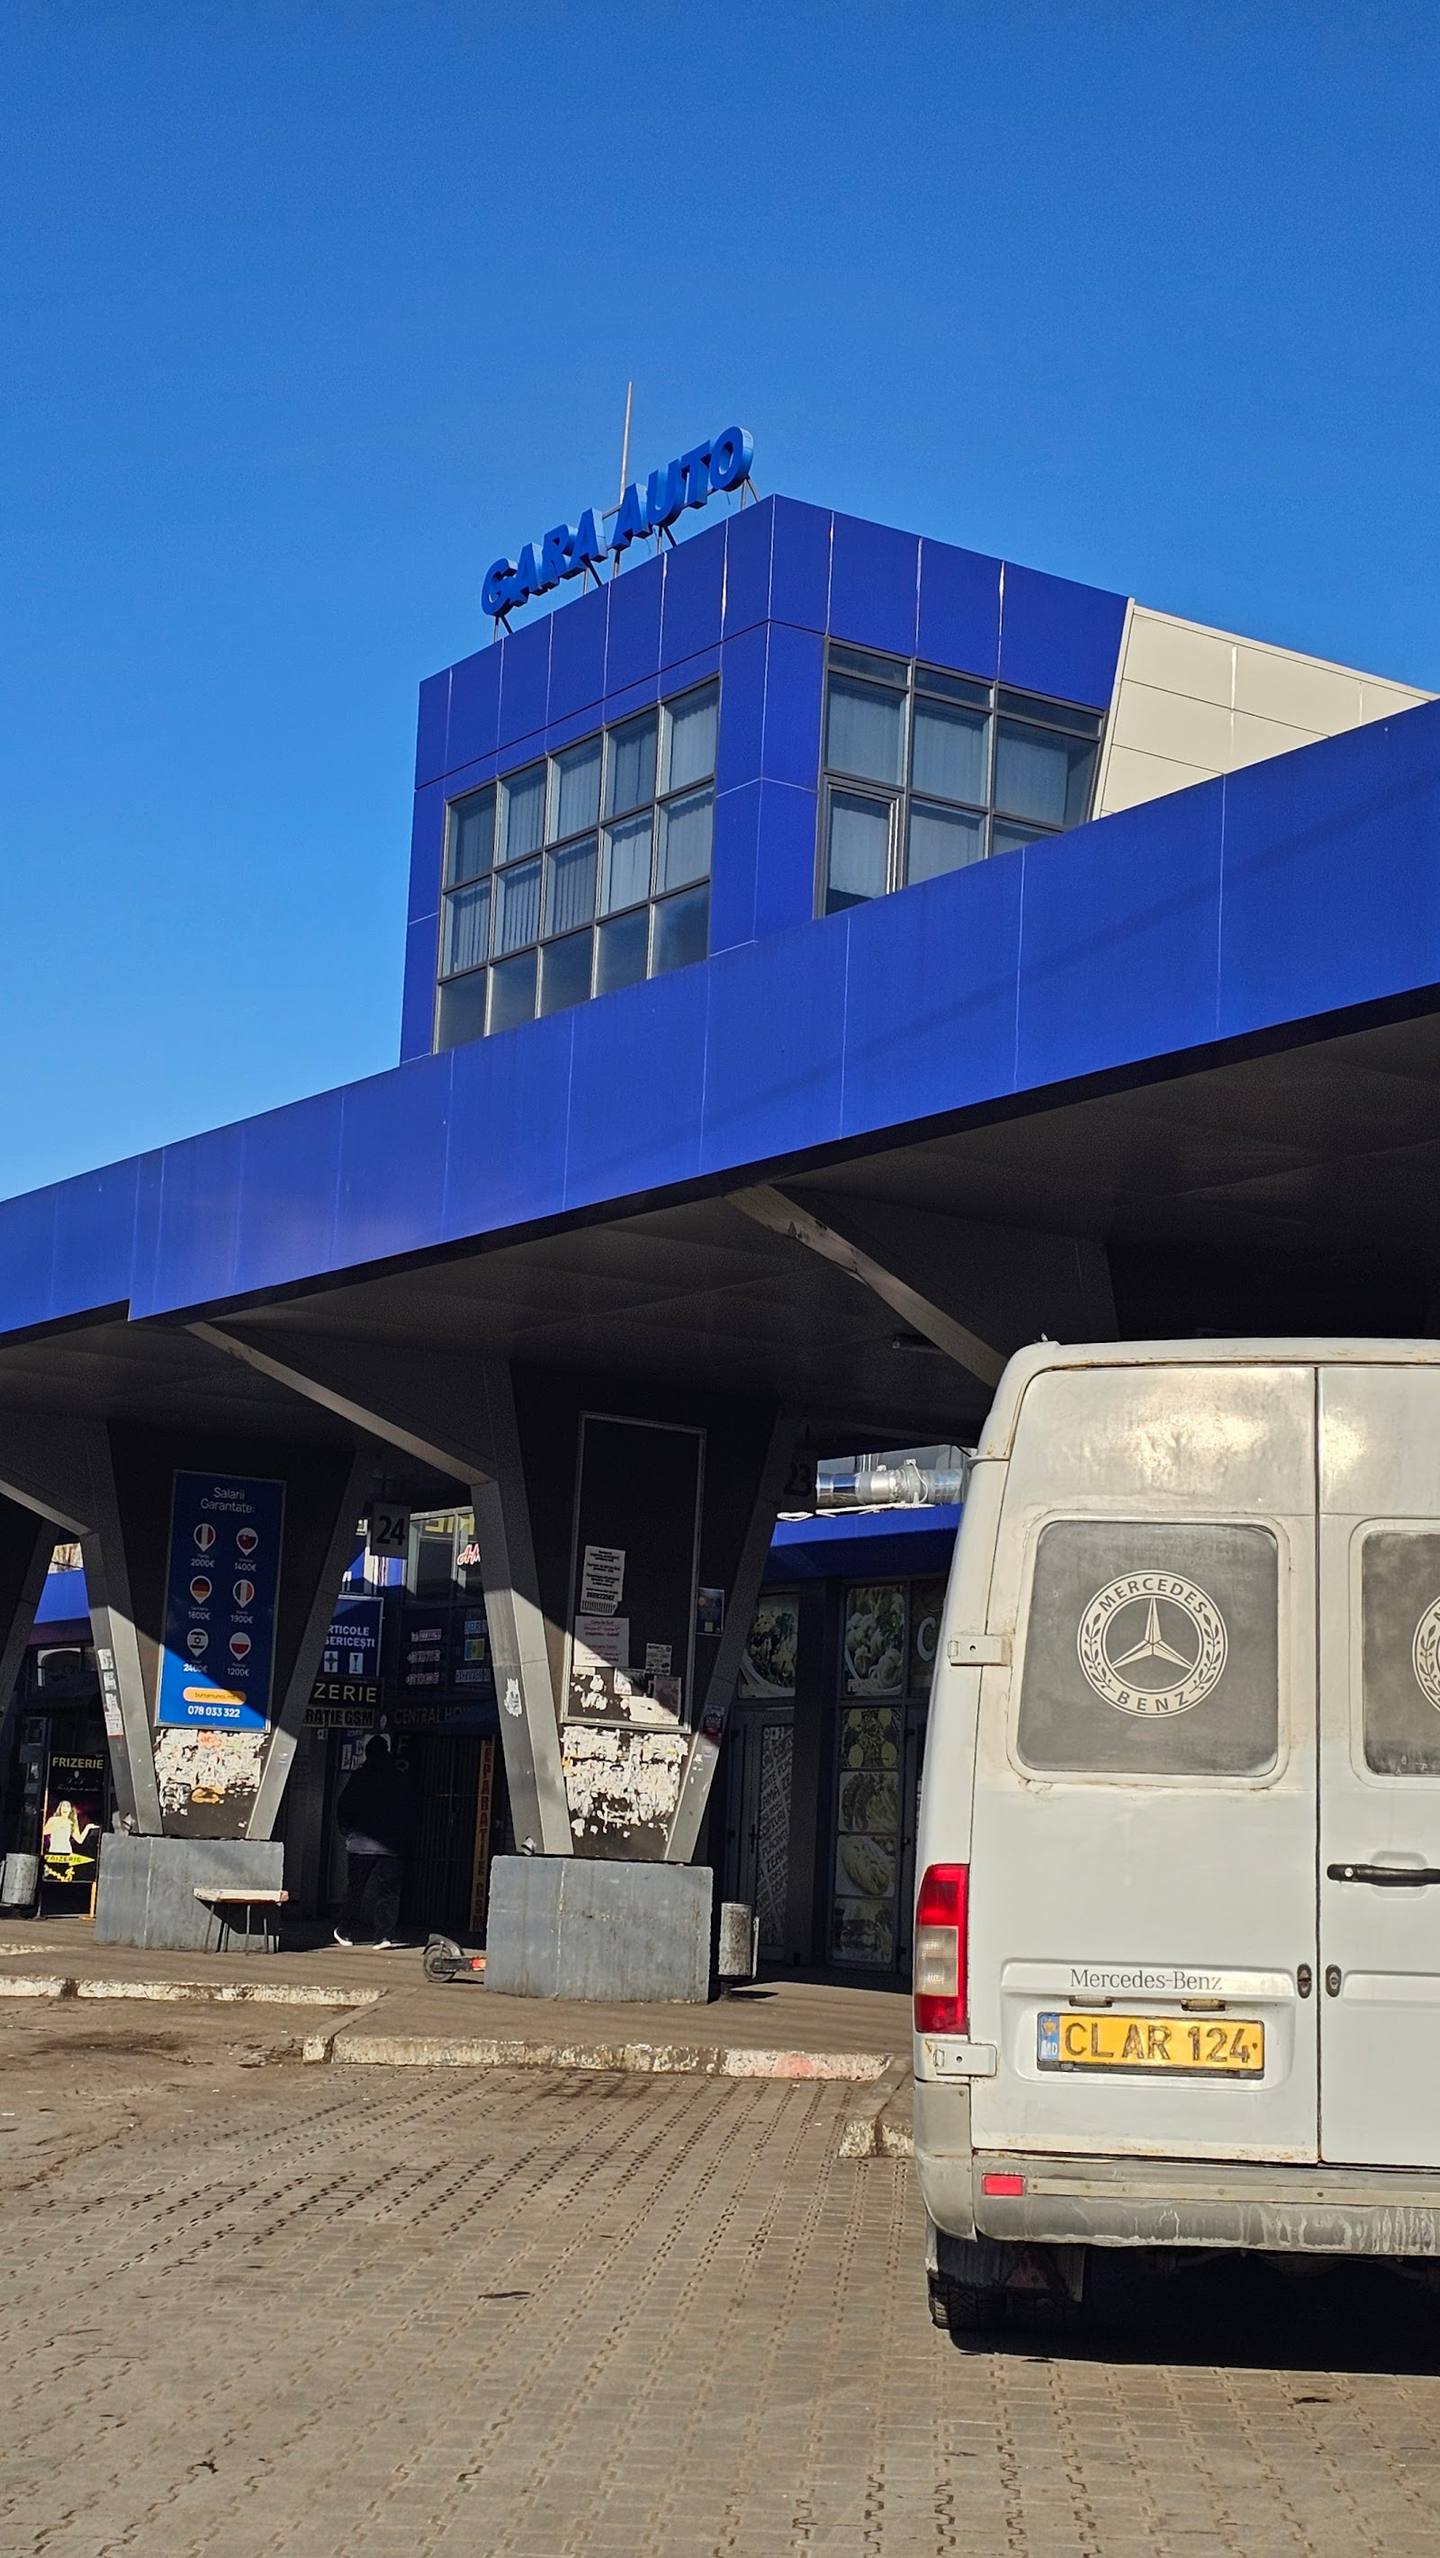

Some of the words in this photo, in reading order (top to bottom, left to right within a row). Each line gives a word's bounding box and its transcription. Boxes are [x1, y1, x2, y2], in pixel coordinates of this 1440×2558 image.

[481, 507, 608, 617] GARA
[610, 425, 754, 551] AUTO
[213, 1486, 246, 1500] Salarii
[200, 1498, 256, 1514] Garantate:
[376, 1515, 405, 1546] 24
[1098, 1578, 1208, 1614] MERCEDES
[326, 1624, 370, 1637] RTICOLE
[324, 1635, 375, 1650] SERICEȘTI
[313, 1682, 378, 1703] ZERIE
[1116, 1690, 1190, 1712] BENZ
[188, 1705, 205, 1716] 078
[205, 1706, 222, 1717] 033
[223, 1707, 241, 1719] 322
[304, 1708, 343, 1725] RATIE
[344, 1710, 373, 1726] GSM
[52, 1756, 104, 1770] FRIZERIE
[477, 1744, 493, 1876] EPARATIE
[1069, 1968, 1224, 1991] Mercedes-Benz
[1064, 2021, 1114, 2058] CL
[1121, 2023, 1171, 2061] AR
[1187, 2025, 1251, 2064] 124
